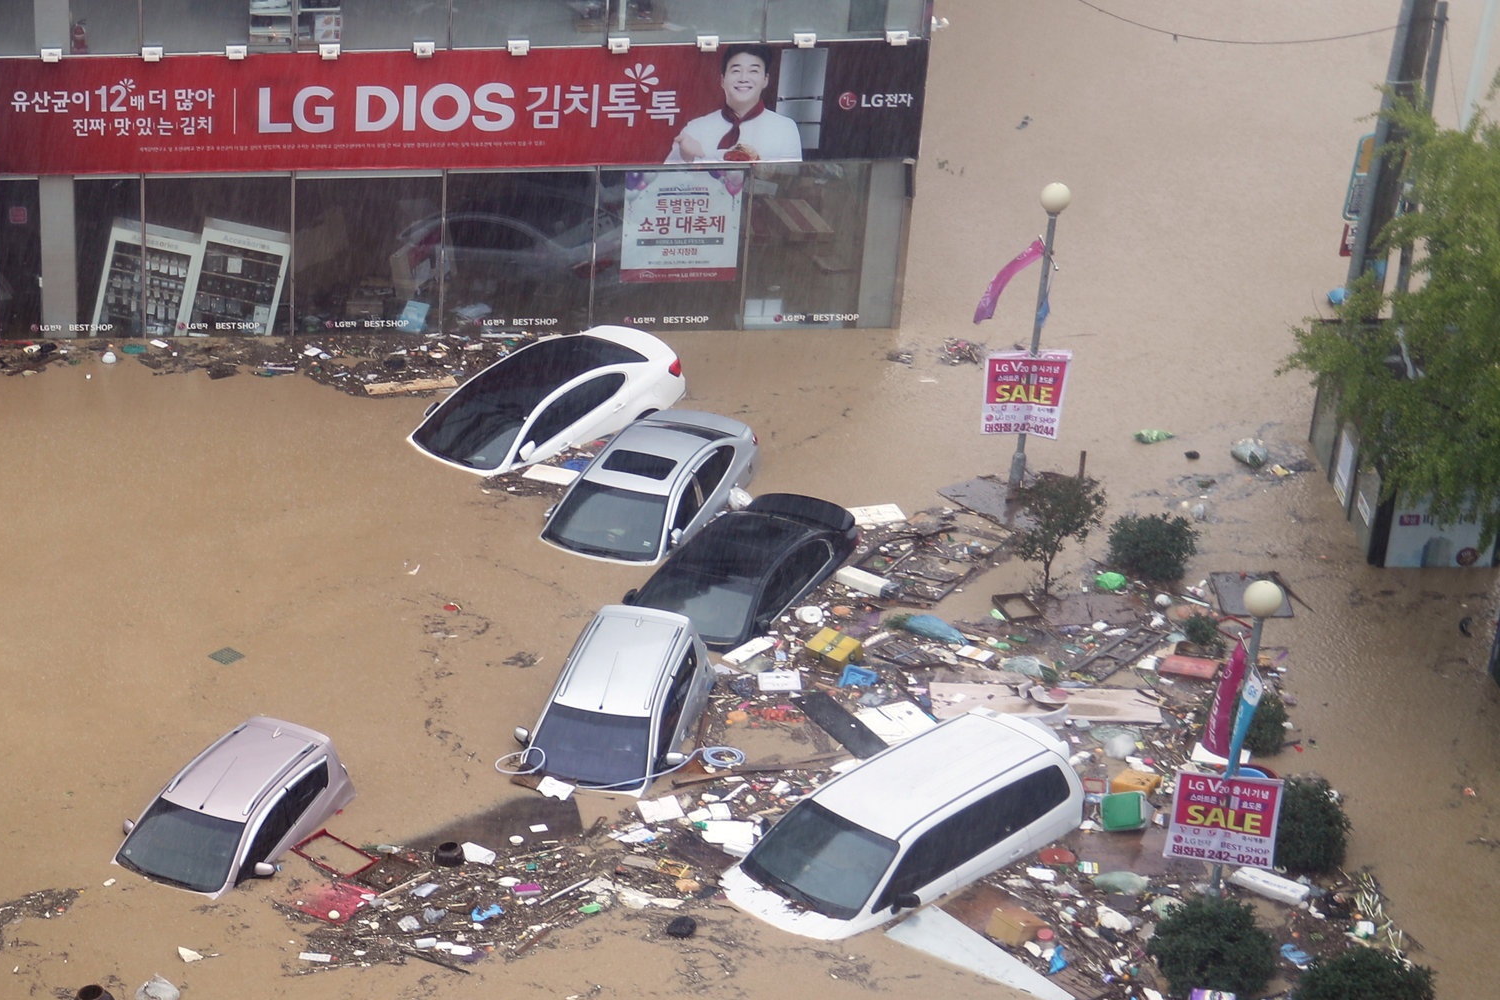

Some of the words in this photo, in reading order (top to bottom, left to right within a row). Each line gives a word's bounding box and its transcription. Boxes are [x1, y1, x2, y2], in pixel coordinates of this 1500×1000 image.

[10, 90, 90, 112] 유산균이
[148, 88, 167, 111] 더
[174, 87, 216, 111] 많아
[257, 86, 335, 134] LG
[354, 82, 517, 132] DIOS
[525, 82, 681, 128] 김치톡톡
[860, 92, 914, 108] LG전자
[72, 118, 106, 137] 진짜
[179, 116, 213, 136] 김치
[655, 198, 709, 214] 특별할인
[637, 216, 671, 235] 쇼핑
[675, 215, 726, 235] 대축제
[222, 233, 271, 251] Accessories
[216, 322, 236, 330] BEST
[238, 322, 259, 330] SHOP
[364, 320, 386, 328] BEST
[387, 320, 409, 328] SHOP
[513, 318, 534, 326] BEST
[535, 318, 557, 326] SHOP
[663, 316, 685, 324] BEST
[686, 316, 708, 324] SHOP
[813, 314, 835, 322] BEST
[836, 314, 859, 322] SHOP
[995, 364, 1008, 372] LG
[1010, 361, 1029, 373] V20
[995, 384, 1054, 405] SALE
[984, 423, 1012, 433] 태화점
[1013, 423, 1054, 436] 242-0244
[1188, 779, 1205, 791] LG
[1207, 779, 1230, 794] V20
[1232, 785, 1270, 800] 출시기념
[1189, 793, 1218, 804] 스마트폰
[1241, 801, 1263, 811] 효도폰
[1186, 804, 1263, 835] SALE
[1172, 844, 1206, 858] 태화점
[1207, 849, 1268, 866] 242-0244
[1184, 837, 1212, 846] LG전자
[1220, 841, 1242, 851] BEST
[1245, 847, 1270, 855] SHOP
